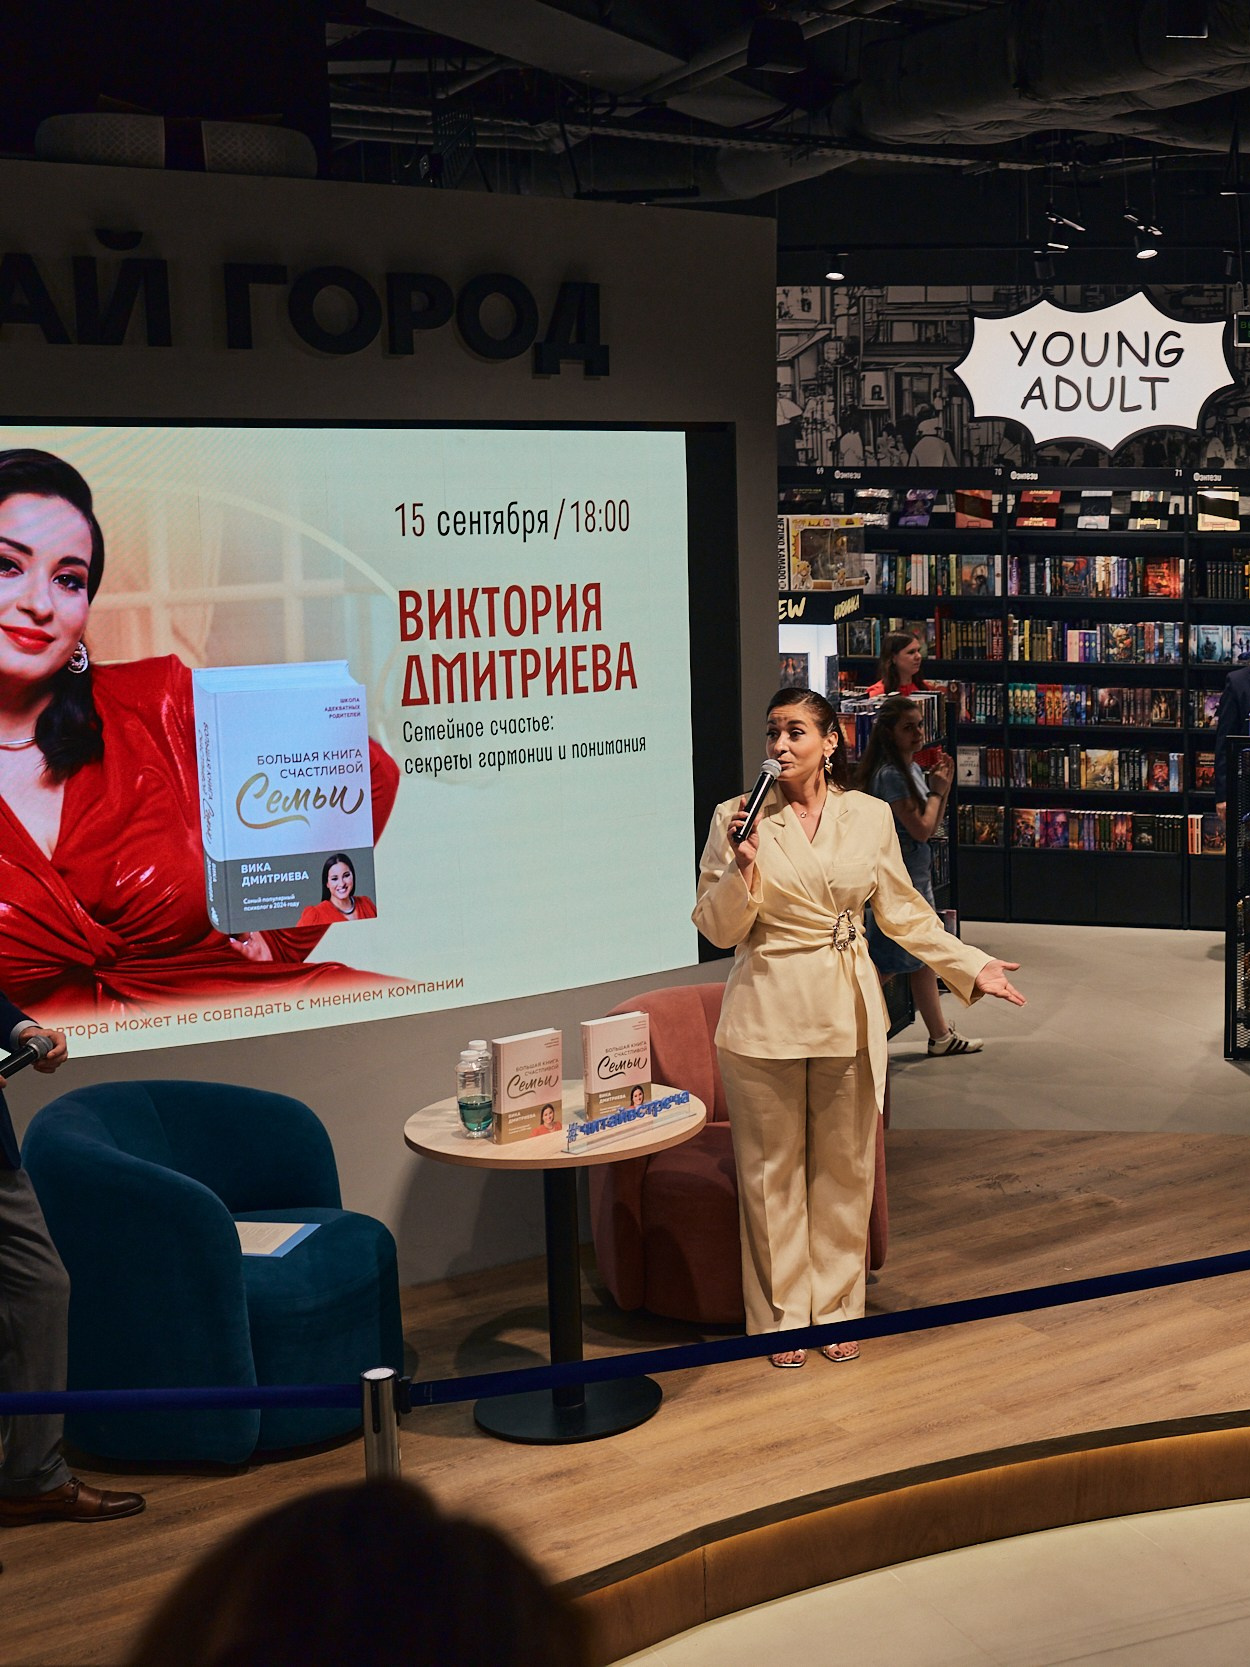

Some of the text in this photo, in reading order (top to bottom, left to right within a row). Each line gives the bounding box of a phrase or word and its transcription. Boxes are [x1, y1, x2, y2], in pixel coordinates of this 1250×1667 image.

[224, 263, 609, 376] ГОРОД
[1010, 330, 1184, 368] YOUNG
[1021, 374, 1170, 412] ADULT
[1193, 472, 1221, 482] Фэнтези
[394, 502, 425, 538] 15
[399, 582, 602, 642] ВИКТОРИЯ
[401, 642, 638, 707] ДМИТРИЕВА
[324, 704, 360, 712] АДЕКВАТНЫХ
[329, 711, 361, 719] РОДИТЕЛЕЙ
[403, 715, 554, 743] Семейное счастье:
[257, 749, 363, 765] БОЛЬШАЯ КНИГА
[405, 736, 647, 777] секреты гармонии и понимания
[280, 760, 364, 778] СЧАСТЛИВОЙ
[236, 772, 364, 830] Семьи
[241, 862, 271, 873] ВИКА
[241, 871, 309, 887] ДМИТРИЕВА
[243, 893, 296, 905] Самый популярный
[115, 1016, 172, 1032] может
[177, 1013, 198, 1025] не
[203, 1000, 292, 1022] совпадать
[297, 1001, 305, 1010] с
[310, 990, 383, 1009] мнением
[388, 977, 465, 998] компании
[605, 1041, 647, 1054] БОЛЬШАЯ КНИГА
[597, 1055, 647, 1079] Семьи
[506, 1074, 559, 1098] Семьи
